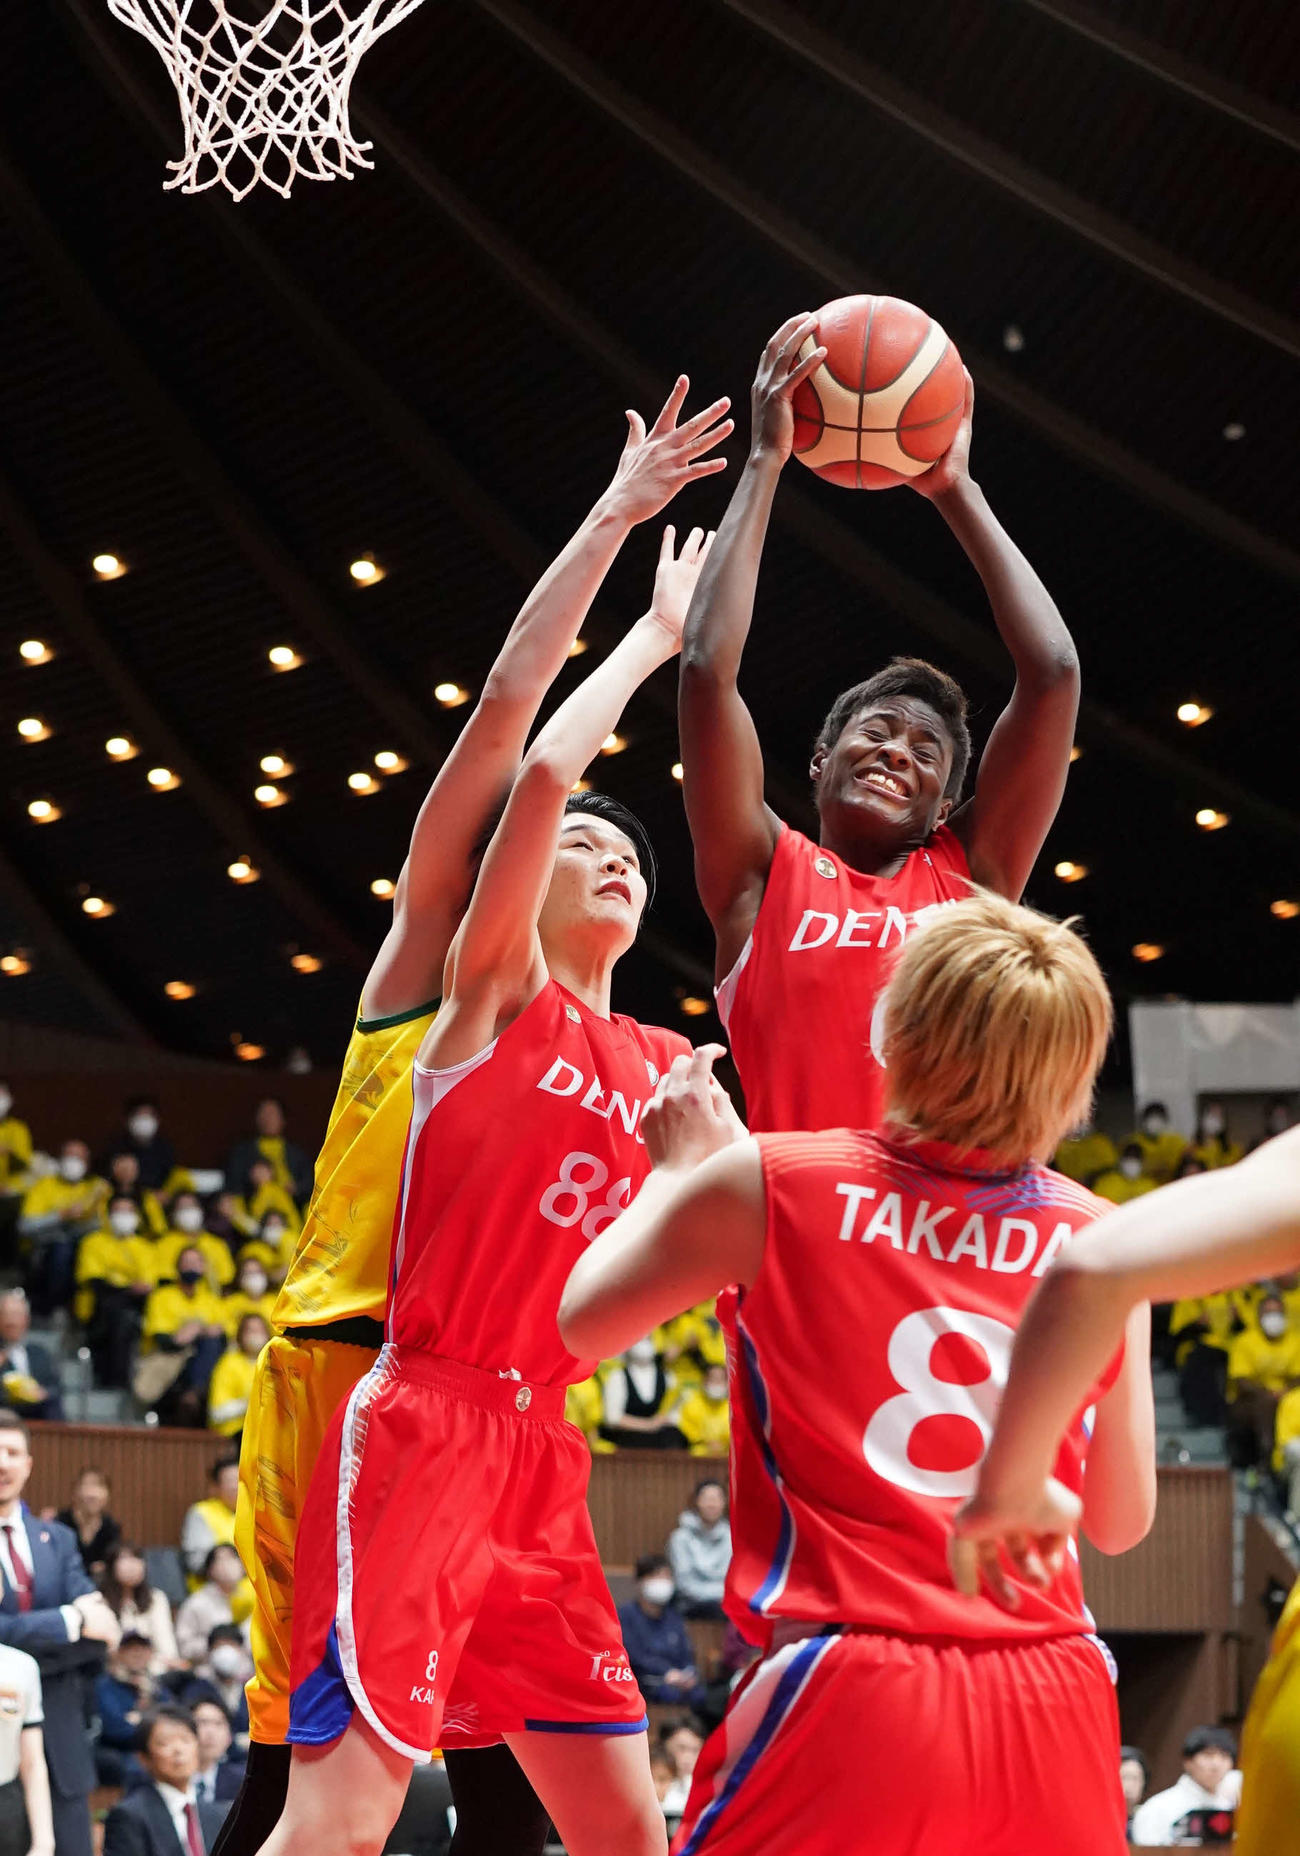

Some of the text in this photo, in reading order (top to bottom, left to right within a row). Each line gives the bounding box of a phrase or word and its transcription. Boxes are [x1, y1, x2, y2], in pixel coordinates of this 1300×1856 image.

[788, 898, 957, 952] DEN
[536, 1055, 645, 1145] DEN
[862, 1305, 1016, 1498] 8
